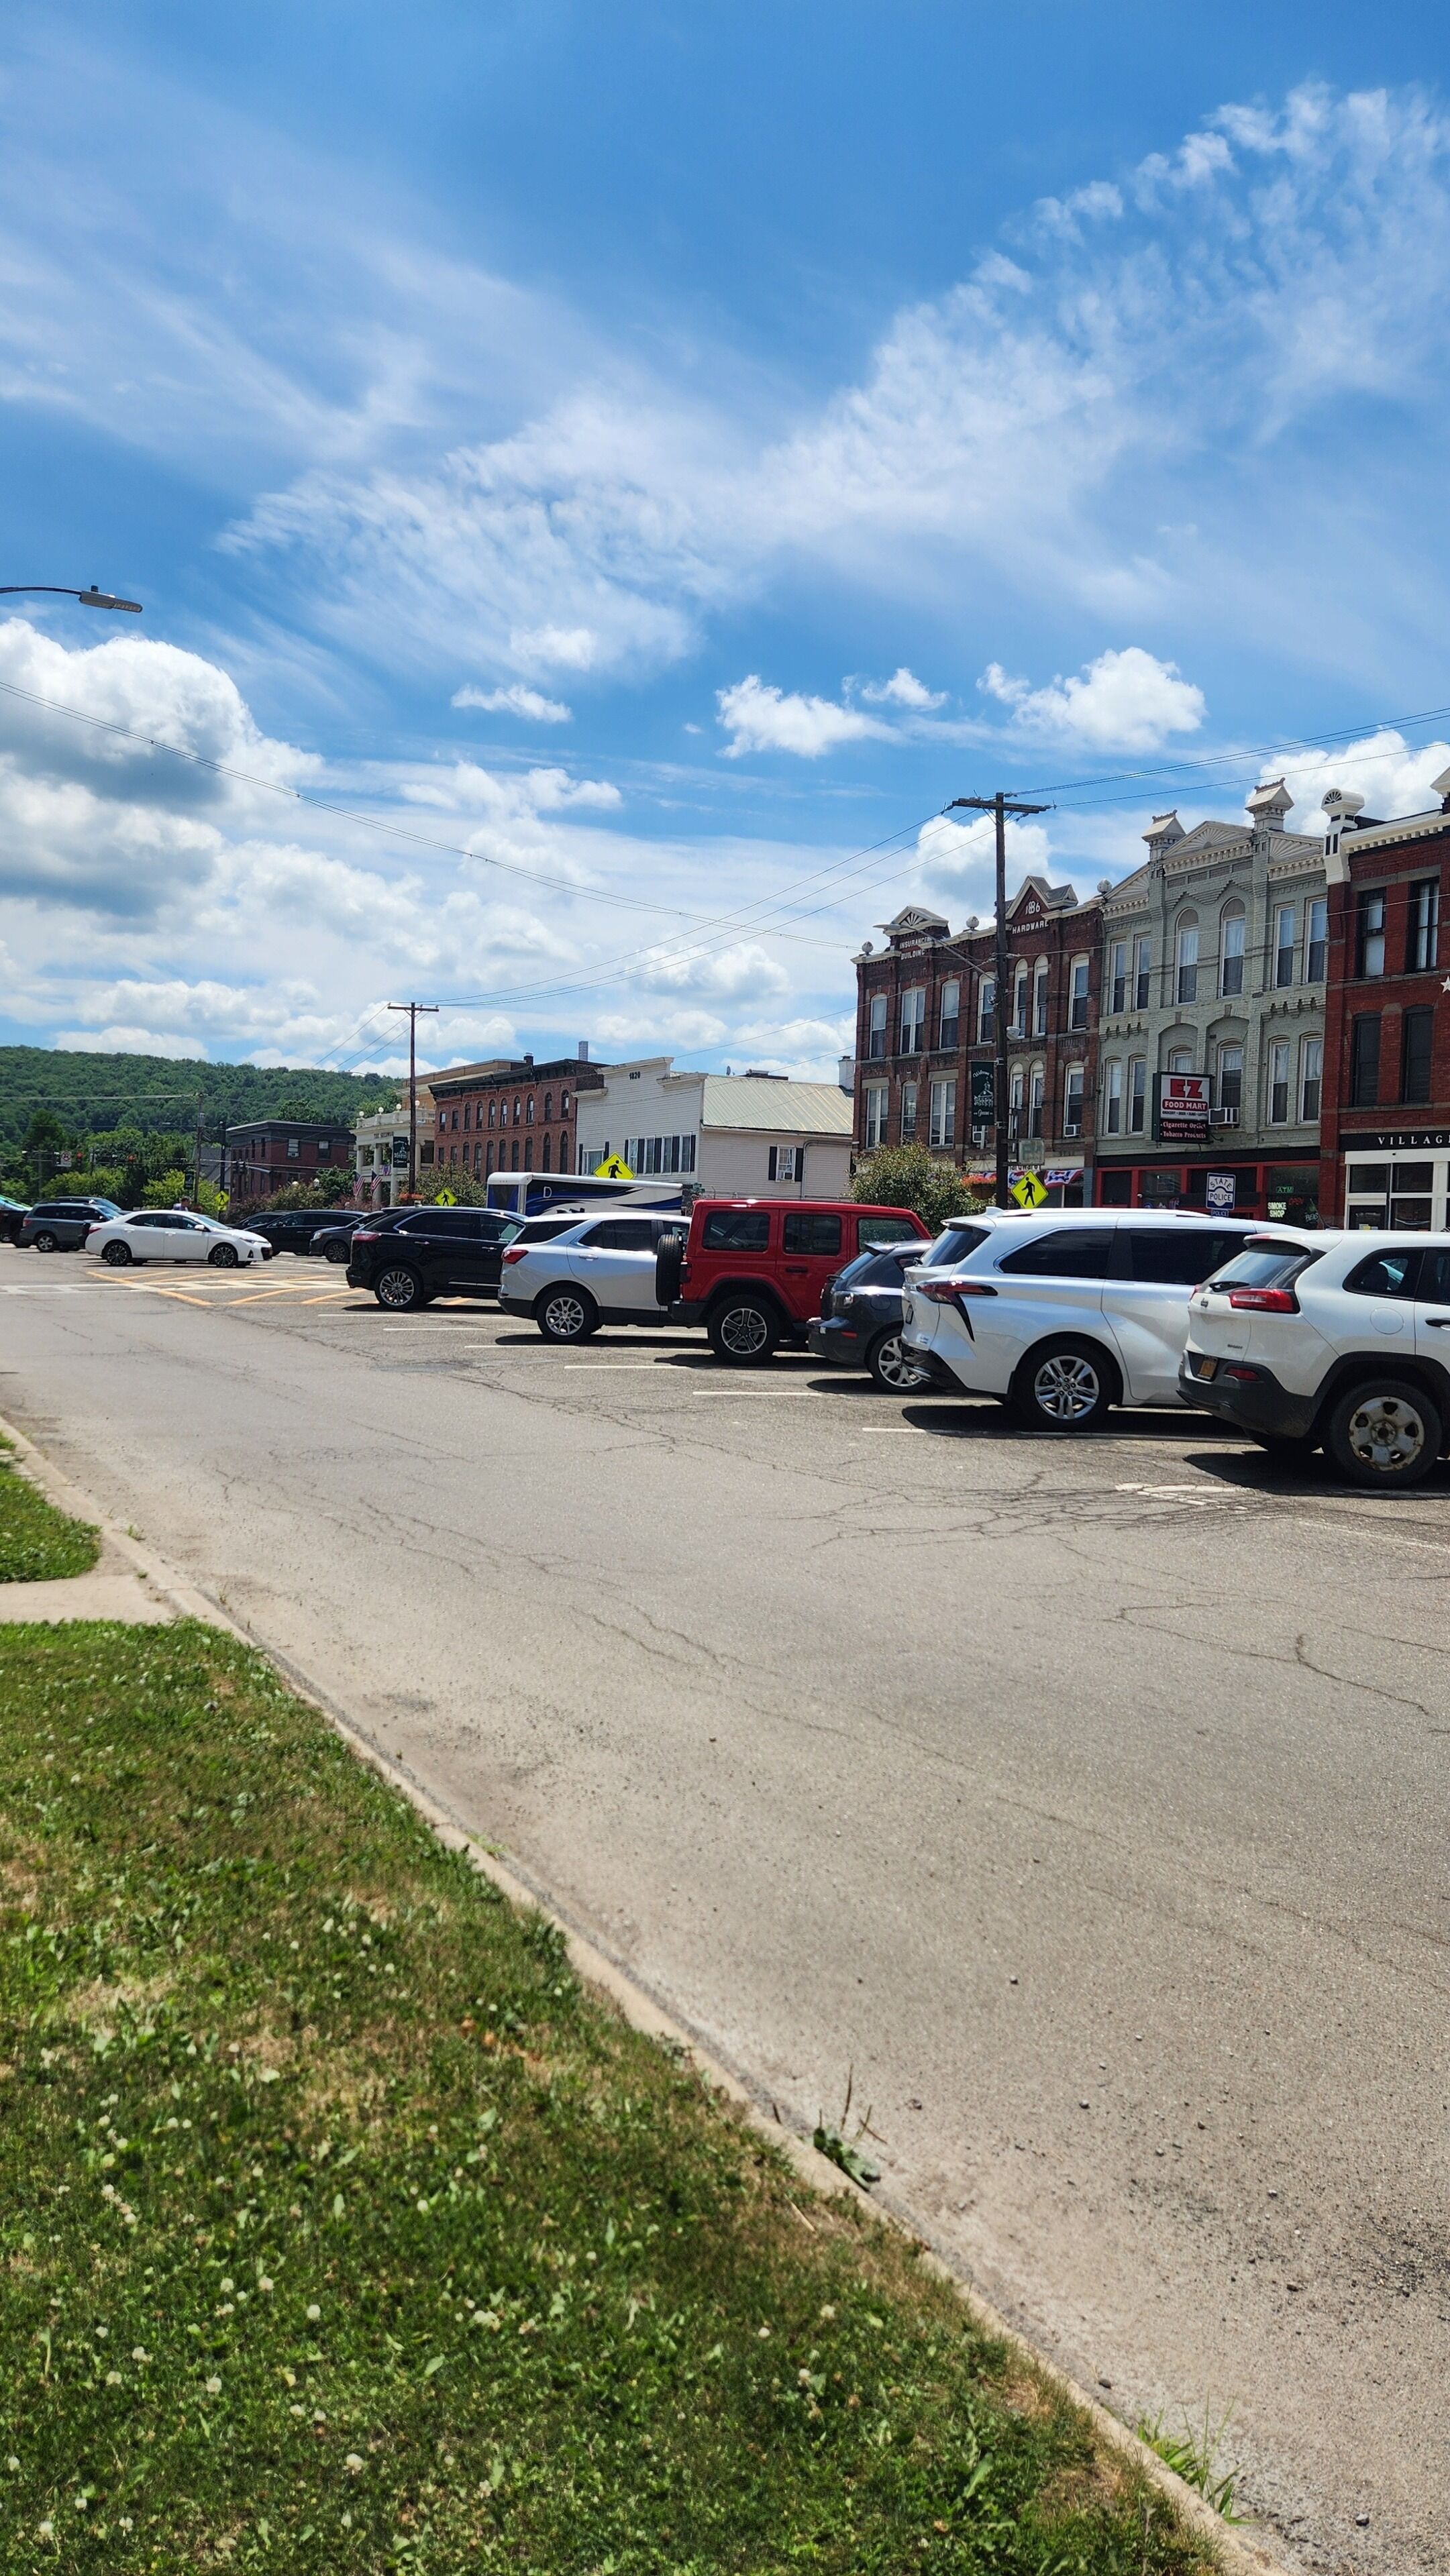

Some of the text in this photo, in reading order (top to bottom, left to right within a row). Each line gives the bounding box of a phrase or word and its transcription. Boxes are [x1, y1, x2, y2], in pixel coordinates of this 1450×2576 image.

[1025, 900, 1041, 915] 1886
[1012, 920, 1049, 934] HARDWARE
[1170, 1078, 1202, 1099] EZ
[1165, 1101, 1184, 1109] FOOD
[1378, 1135, 1450, 1145] VILLAG
[1210, 1178, 1233, 1190] STATE
[543, 1186, 552, 1198] D
[1267, 1202, 1287, 1210] SMOKE
[1270, 1210, 1285, 1218] SHOP
